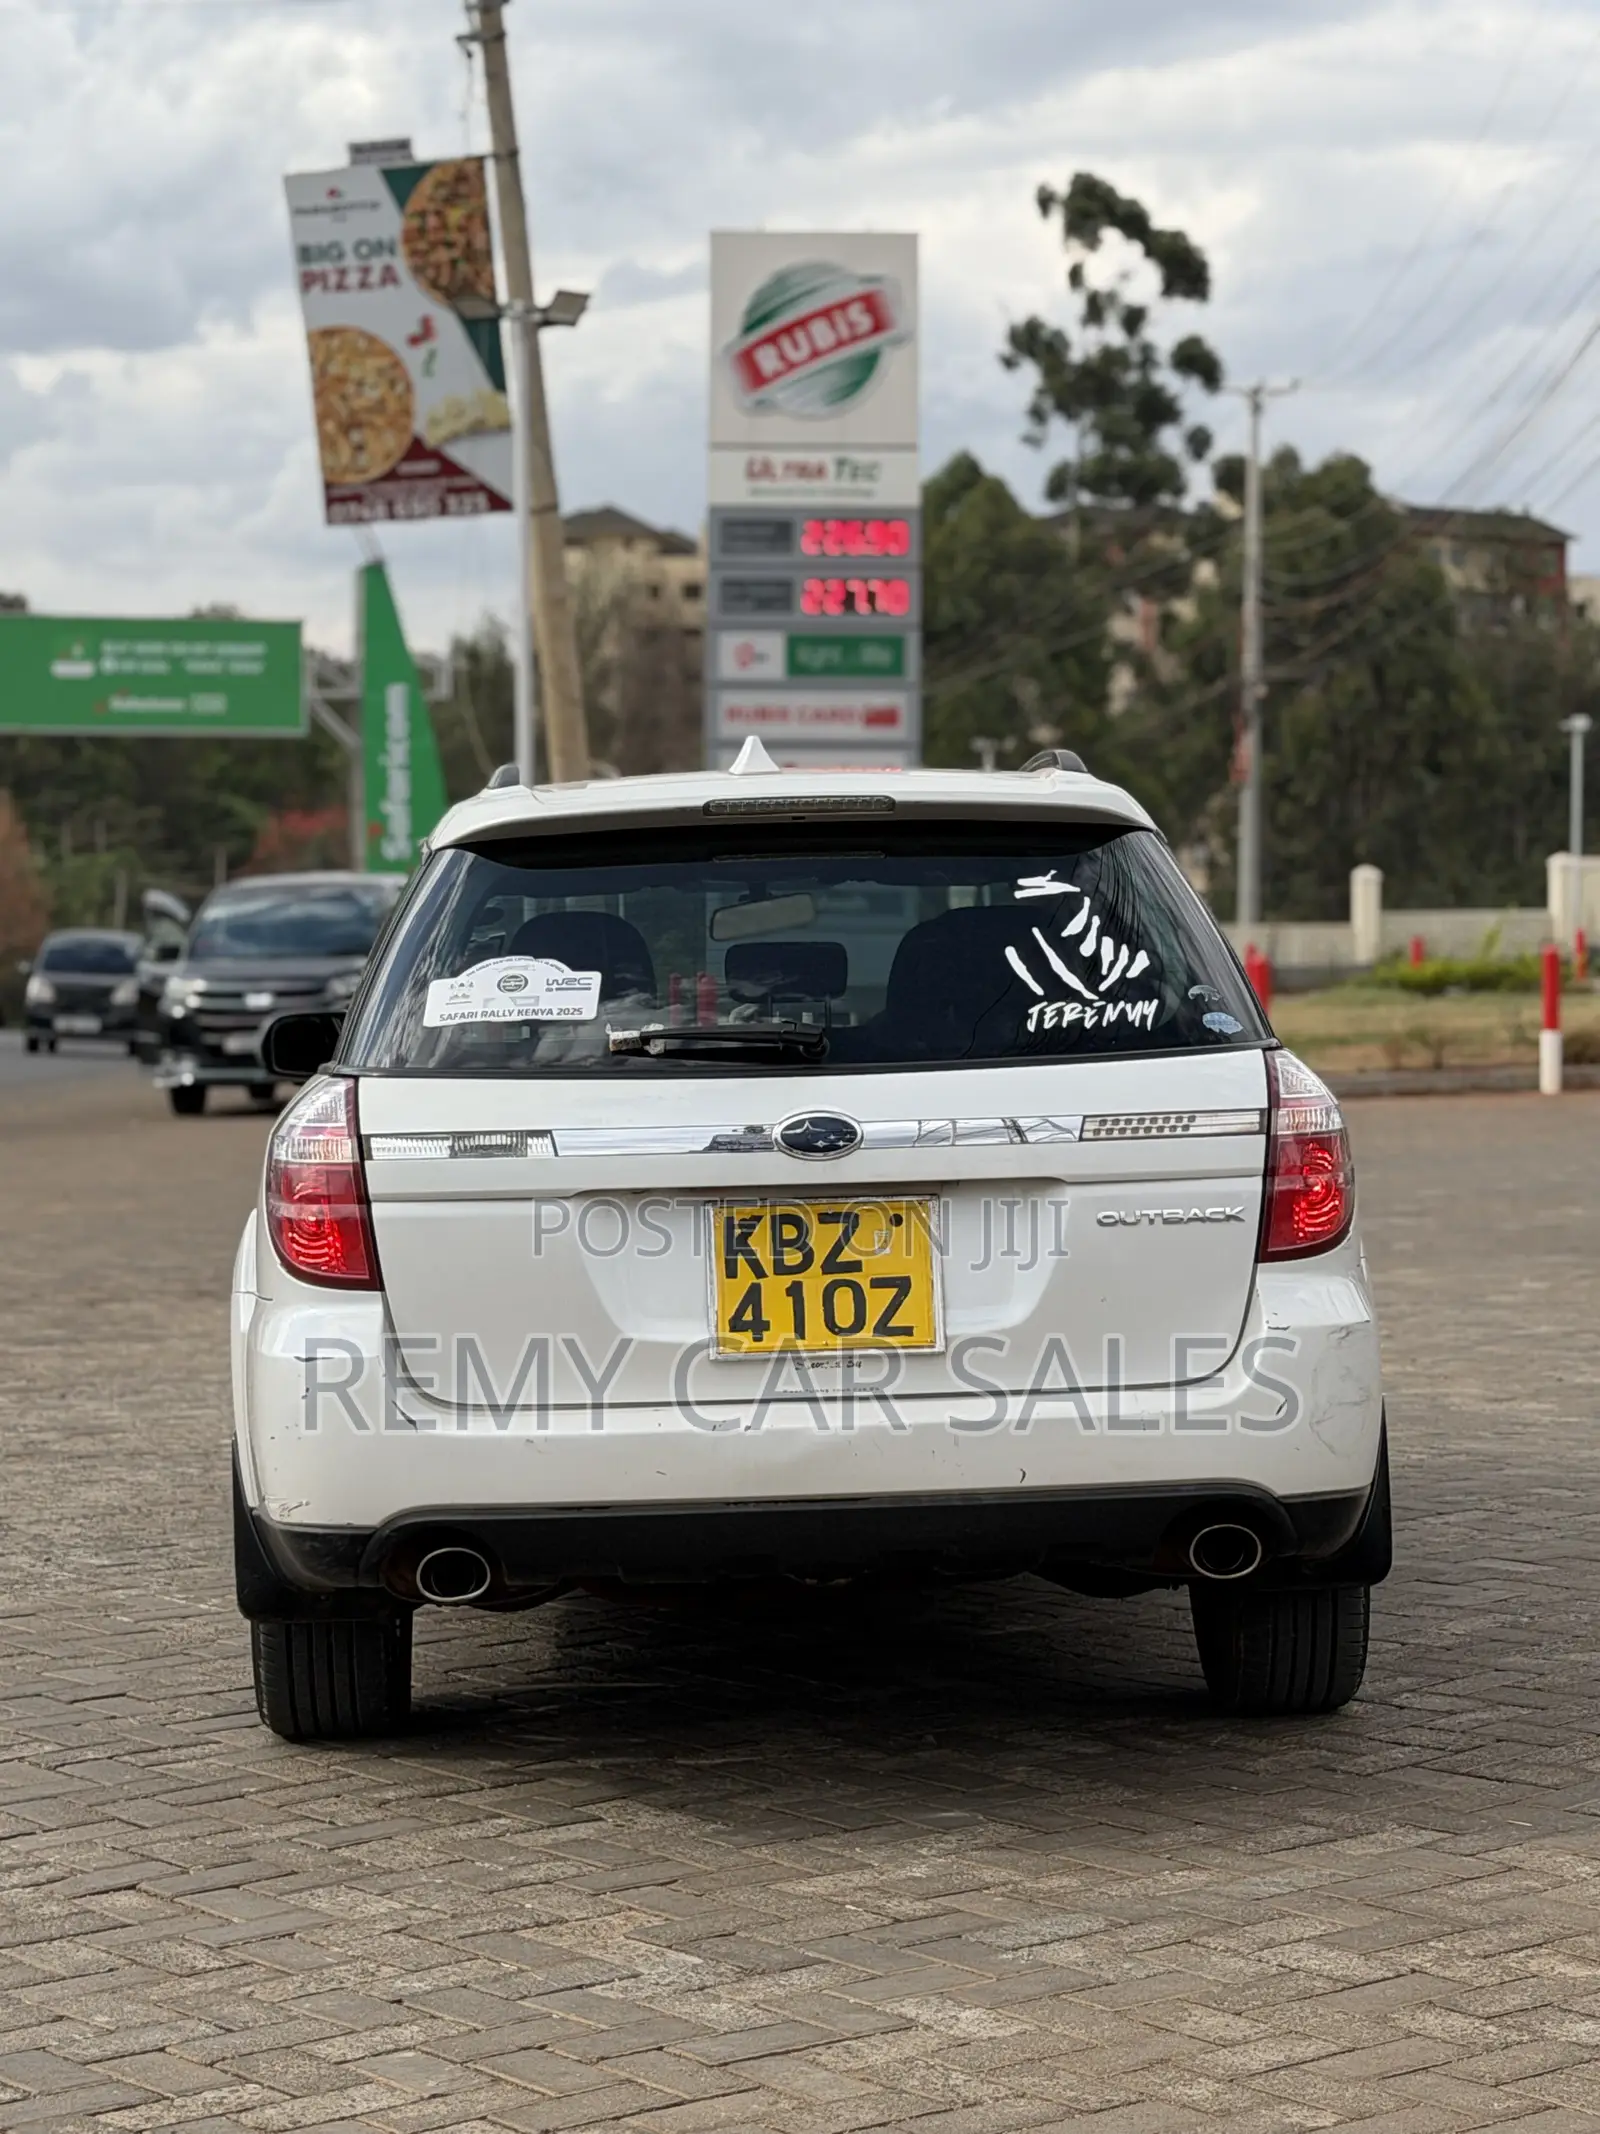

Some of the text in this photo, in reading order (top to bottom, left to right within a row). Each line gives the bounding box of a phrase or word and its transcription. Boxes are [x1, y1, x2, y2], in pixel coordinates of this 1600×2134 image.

[299, 236, 399, 264] BIG ON
[301, 264, 402, 294] PIZZA
[751, 298, 875, 379] RUBIS
[439, 1007, 583, 1022] SAFARI RALLY KENYA 2025
[1096, 1205, 1246, 1227] OUTBACK
[723, 1211, 864, 1280] KBZ
[727, 1275, 915, 1343] 410Z
